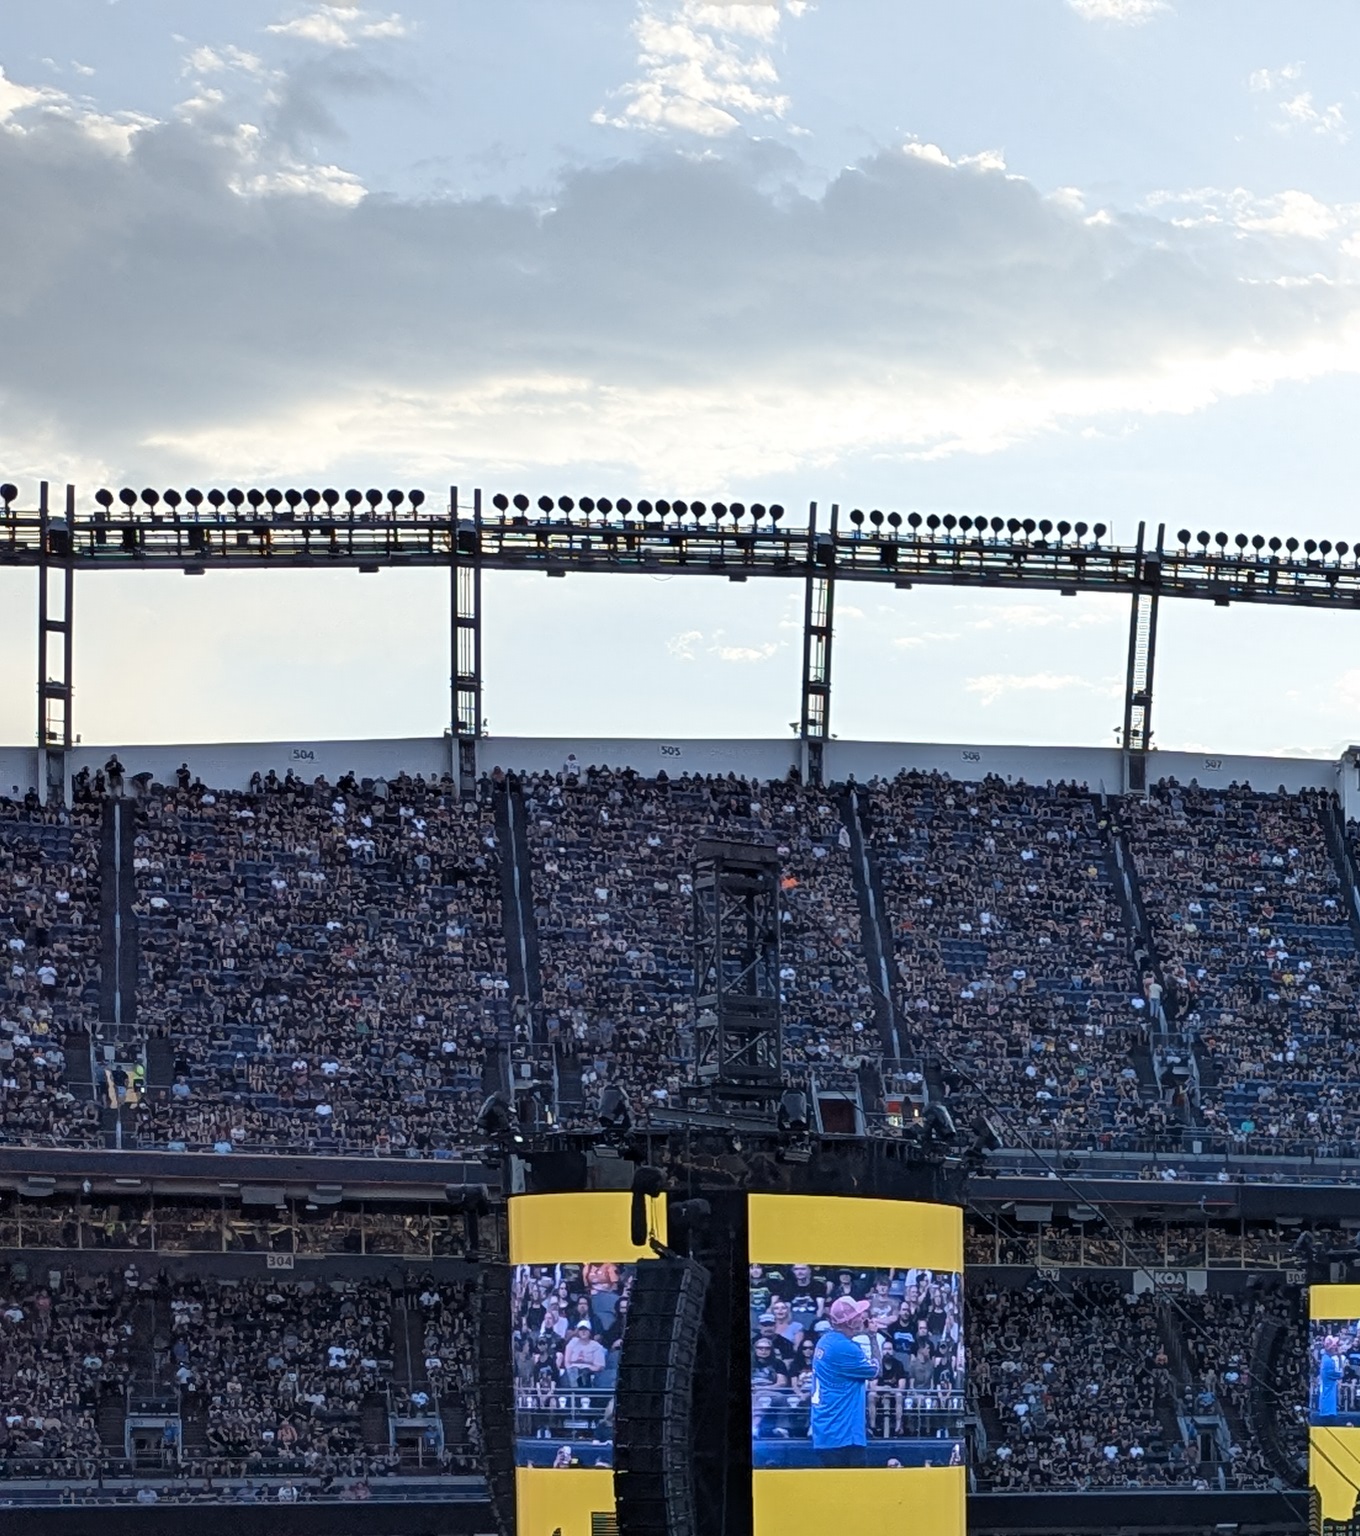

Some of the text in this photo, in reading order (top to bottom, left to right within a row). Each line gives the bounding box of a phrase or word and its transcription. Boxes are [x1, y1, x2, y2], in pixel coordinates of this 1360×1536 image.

[293, 749, 315, 760] 504
[661, 745, 681, 756] 505
[962, 750, 981, 761] 506
[1205, 760, 1222, 769] 507
[268, 1256, 292, 1267] 304
[1155, 1272, 1185, 1285] KOA
